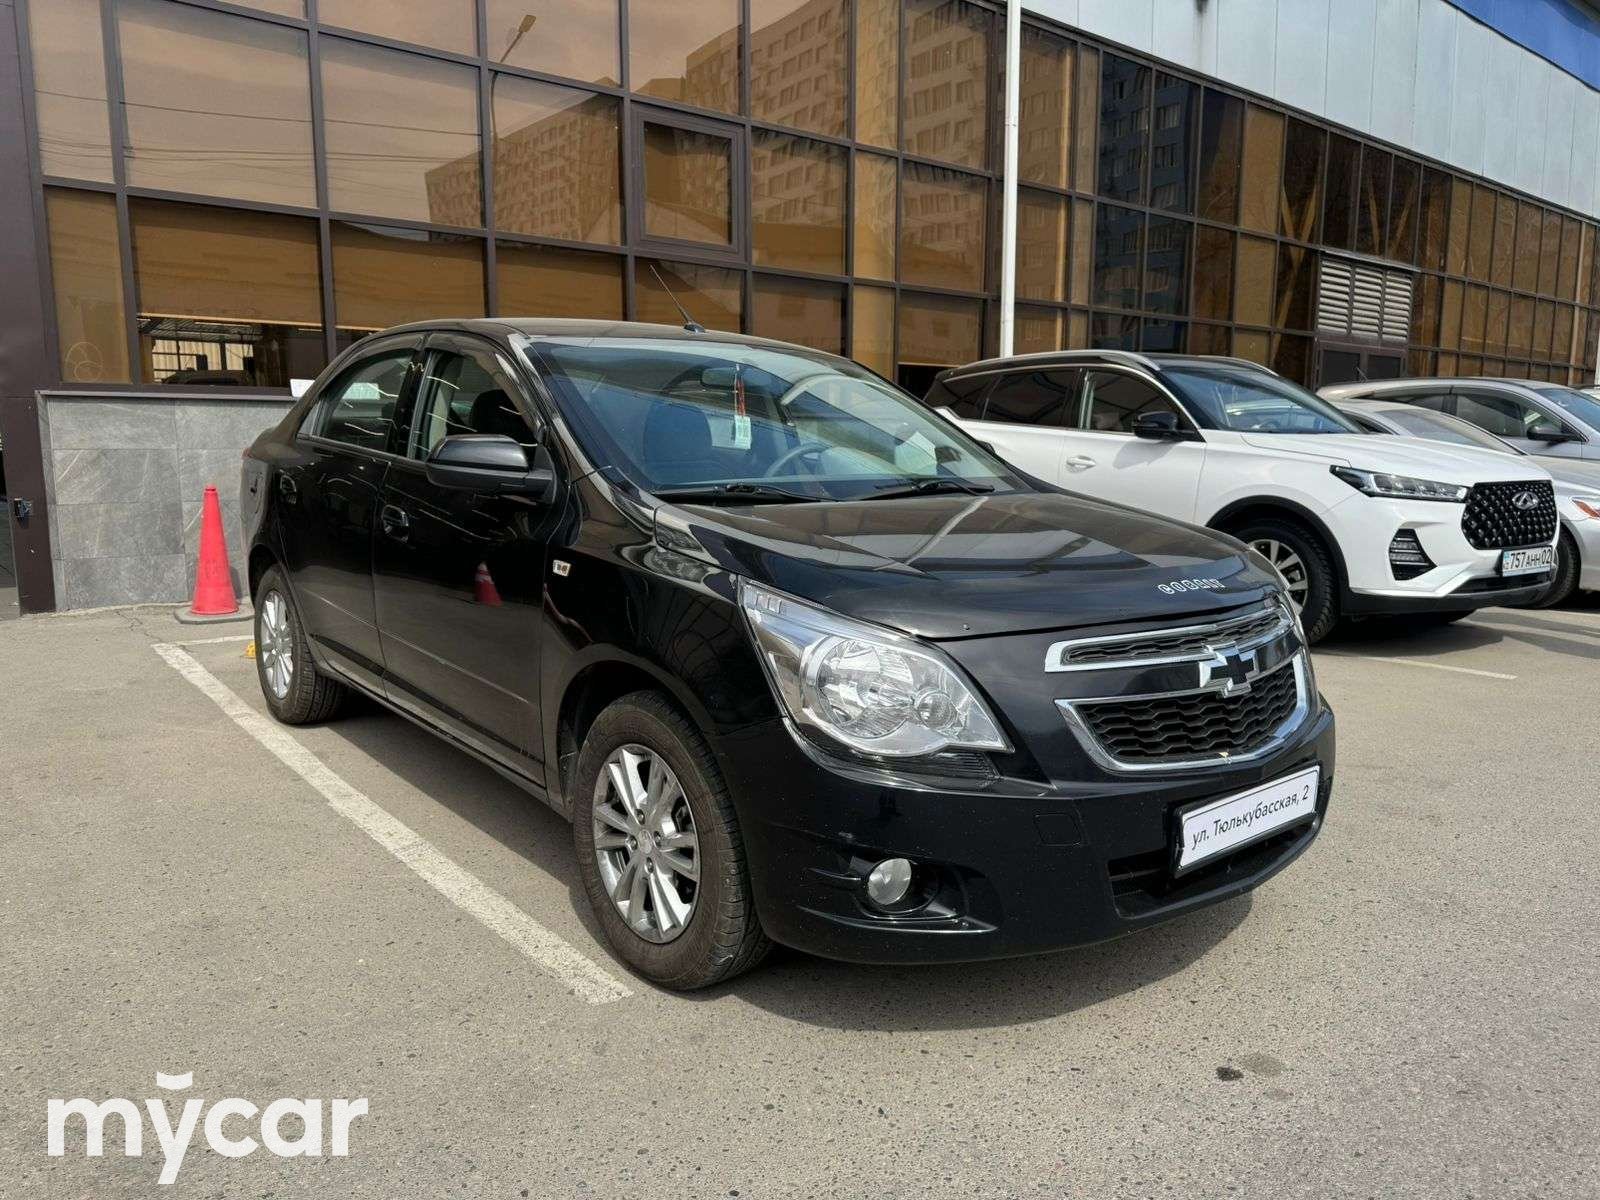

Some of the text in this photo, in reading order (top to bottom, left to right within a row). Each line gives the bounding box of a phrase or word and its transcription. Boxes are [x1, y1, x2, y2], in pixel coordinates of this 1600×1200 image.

[1191, 784, 1310, 851] ул. Тюлькубасская, 2
